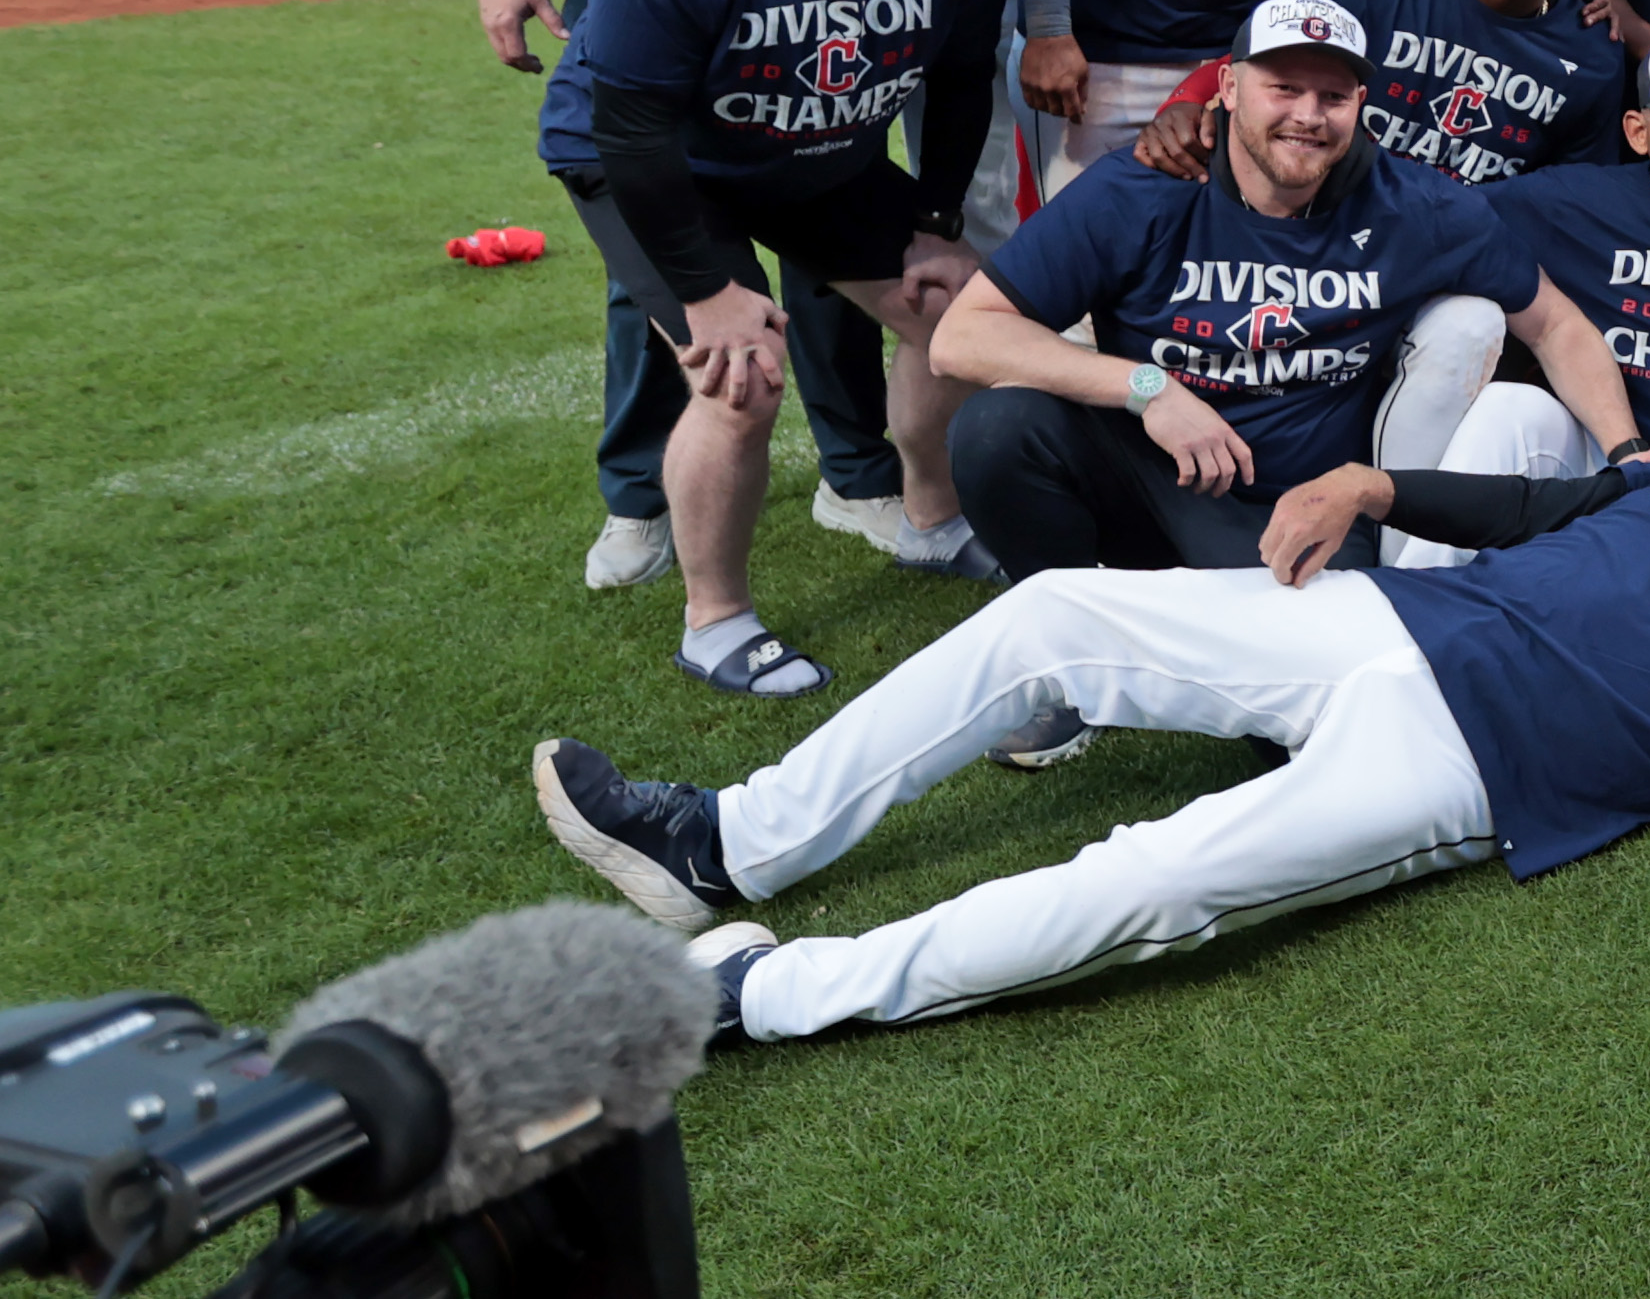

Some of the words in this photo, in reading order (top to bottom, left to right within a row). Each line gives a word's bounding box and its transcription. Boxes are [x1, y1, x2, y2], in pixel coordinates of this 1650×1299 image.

[1269, 4, 1356, 46] CHAMPIONS
[815, 39, 859, 94] C
[1383, 30, 1567, 126] DIVISION
[714, 67, 923, 134] CHAMPS
[1444, 86, 1487, 135] C
[1362, 105, 1526, 183] CHAMPS
[1169, 261, 1381, 310] DIVISION
[1251, 303, 1292, 351] C
[1151, 337, 1371, 386] CHAMPS
